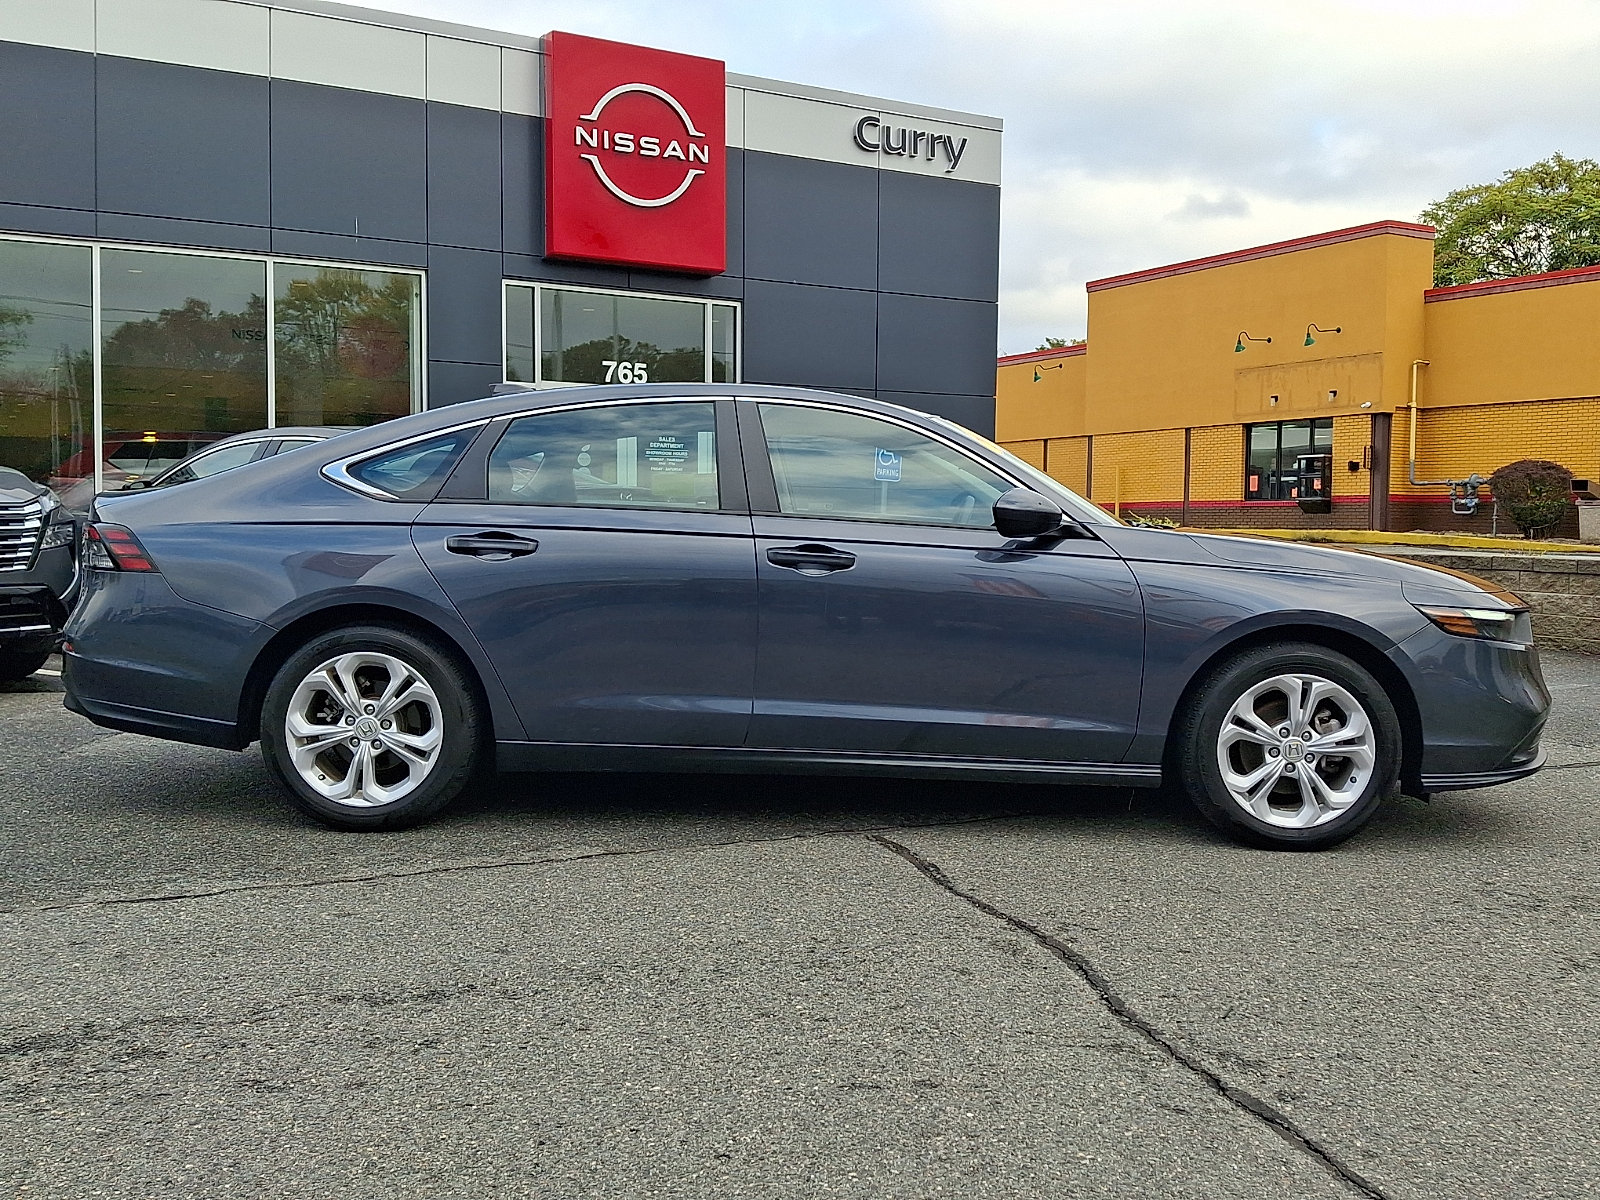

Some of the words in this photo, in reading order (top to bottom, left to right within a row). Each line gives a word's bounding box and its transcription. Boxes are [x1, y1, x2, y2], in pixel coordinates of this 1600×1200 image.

[574, 125, 709, 164] NISSAN
[854, 115, 968, 173] Curry
[601, 360, 648, 384] 765
[876, 468, 899, 476] PARKING
